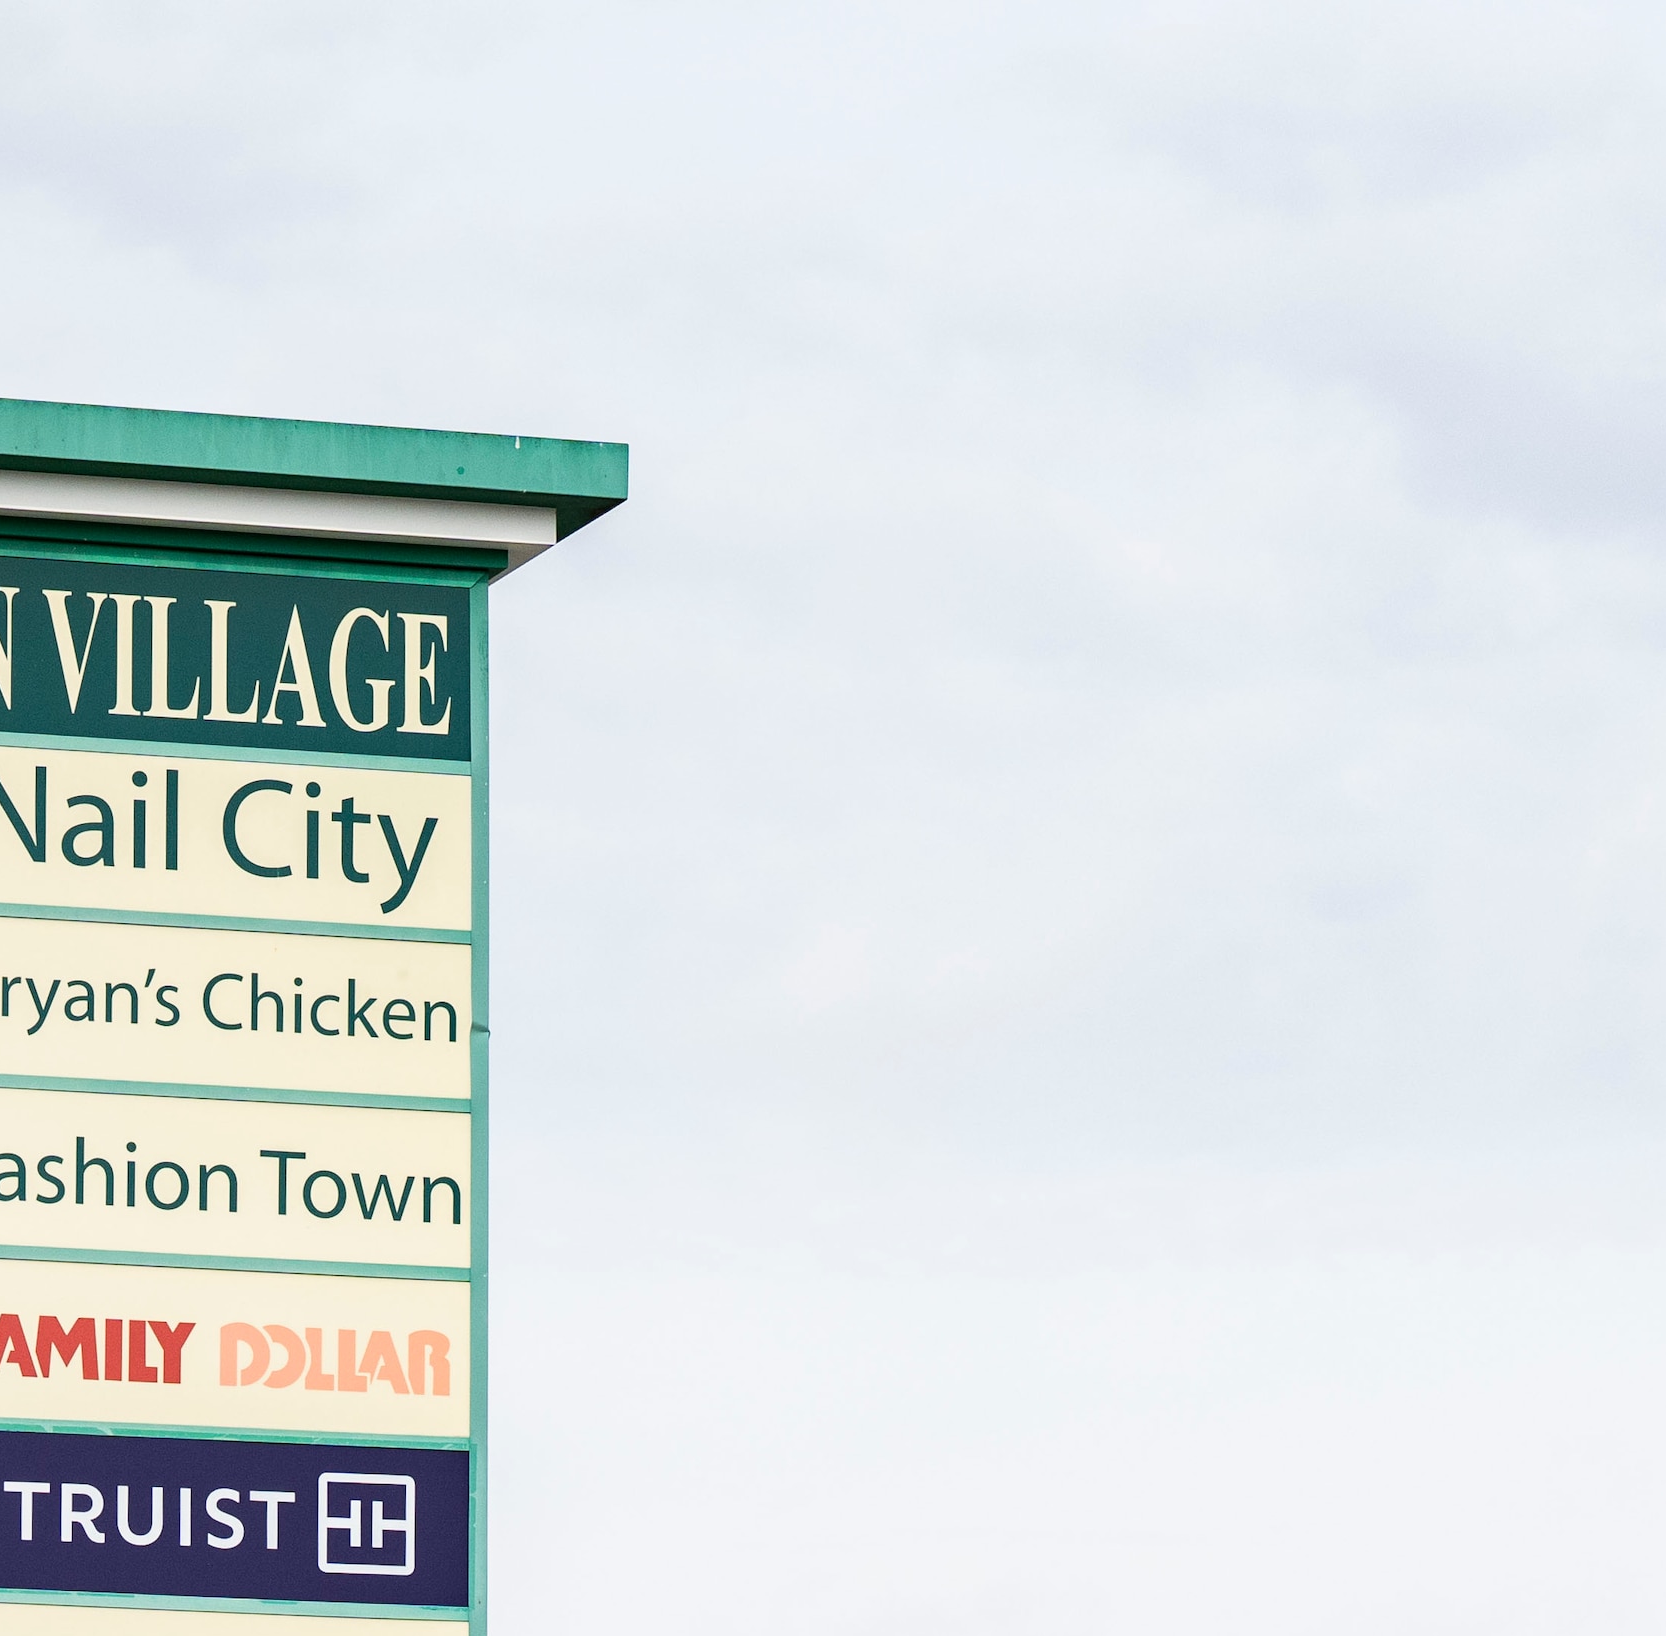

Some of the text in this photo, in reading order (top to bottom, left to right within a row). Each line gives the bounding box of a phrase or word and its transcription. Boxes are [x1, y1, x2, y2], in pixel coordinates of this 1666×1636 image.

[42, 590, 451, 734] VILLAGE
[223, 780, 438, 914] City
[203, 973, 456, 1042] Chicken
[260, 1150, 460, 1224] Town
[220, 1322, 450, 1396] DOLLAR
[4, 1481, 295, 1549] TRUIST
